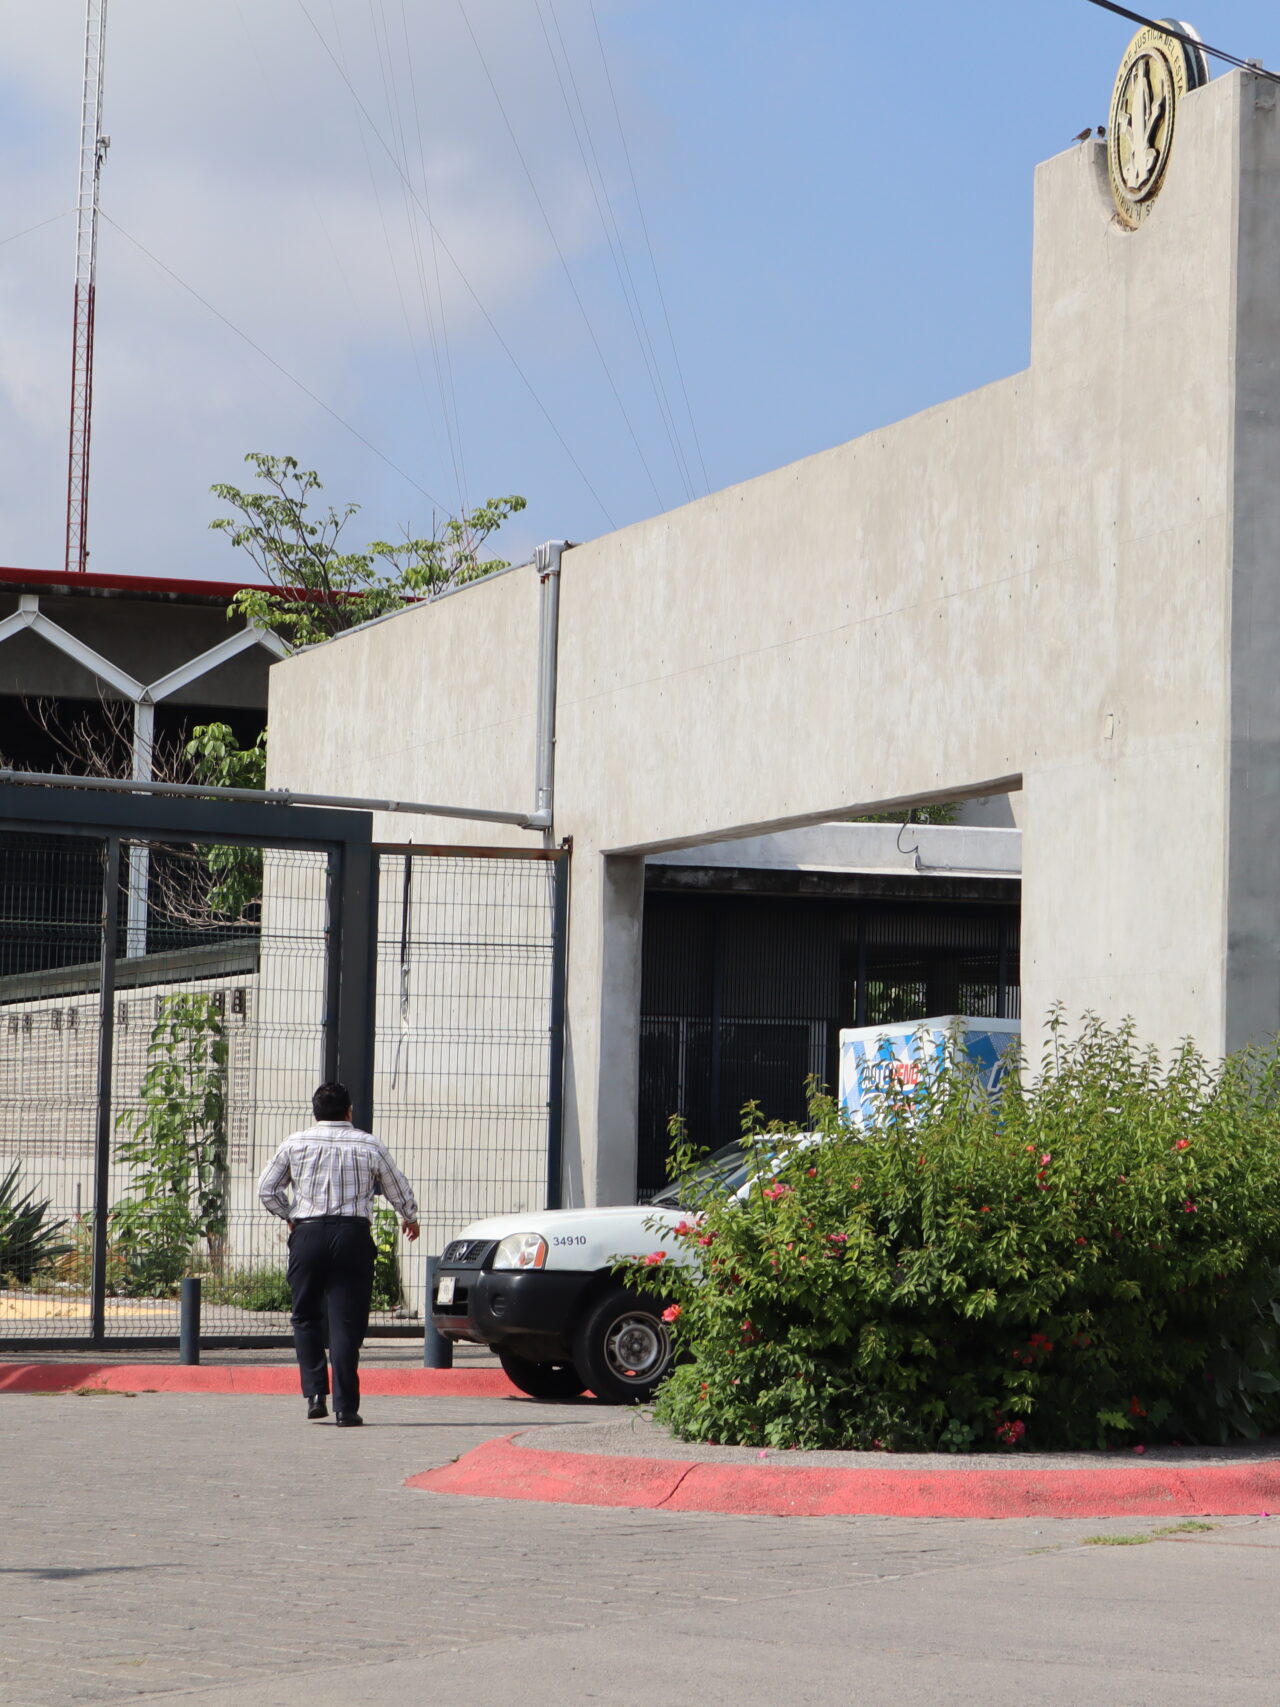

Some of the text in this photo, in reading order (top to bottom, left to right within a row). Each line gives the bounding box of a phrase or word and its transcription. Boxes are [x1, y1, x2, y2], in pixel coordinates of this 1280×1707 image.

[1134, 28, 1163, 54] JUSTICIA
[1173, 55, 1184, 97] ESTA
[553, 1235, 587, 1246] 34910
